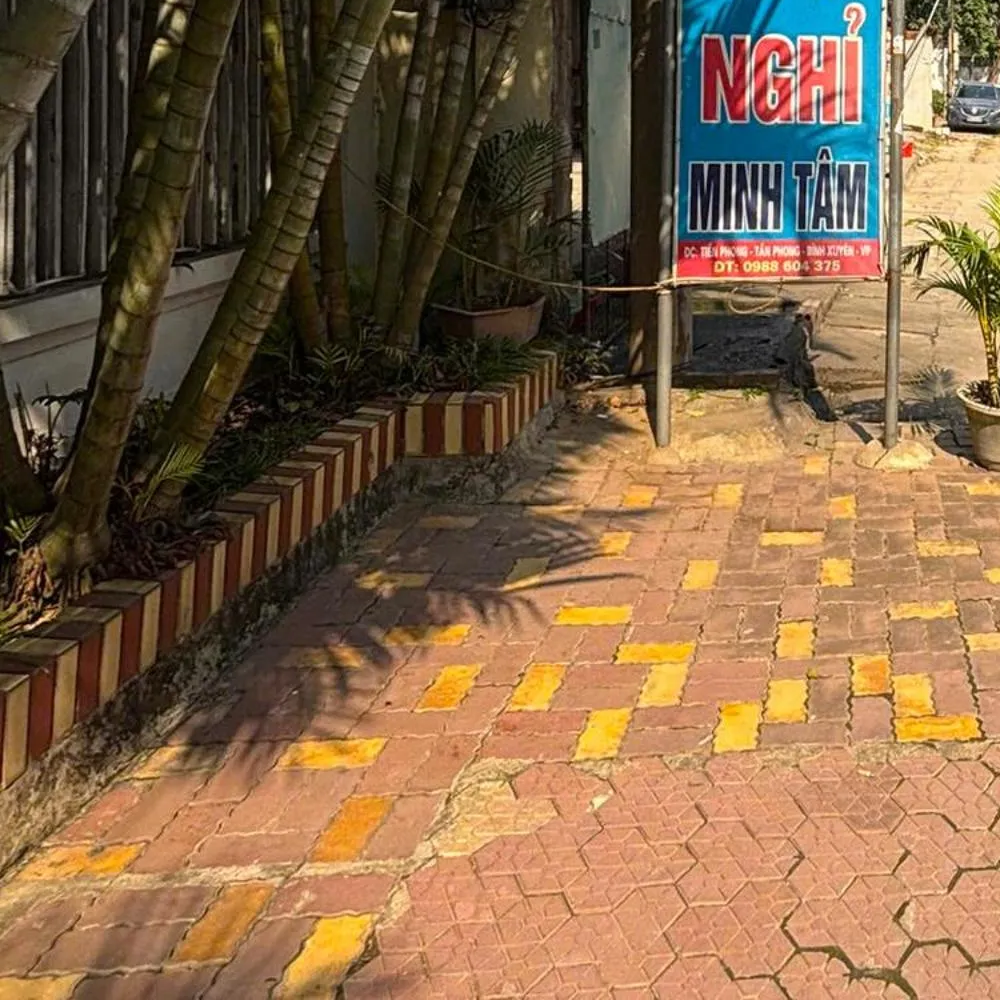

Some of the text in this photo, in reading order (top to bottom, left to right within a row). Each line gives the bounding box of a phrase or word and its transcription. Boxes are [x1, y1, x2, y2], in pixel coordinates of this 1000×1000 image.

[700, 2, 865, 124] NGHỈ
[687, 147, 867, 233] MINH TÂM
[719, 245, 748, 258] PHONG
[772, 245, 800, 257] PHONG
[743, 260, 779, 273] 0988
[814, 260, 841, 272] 375
